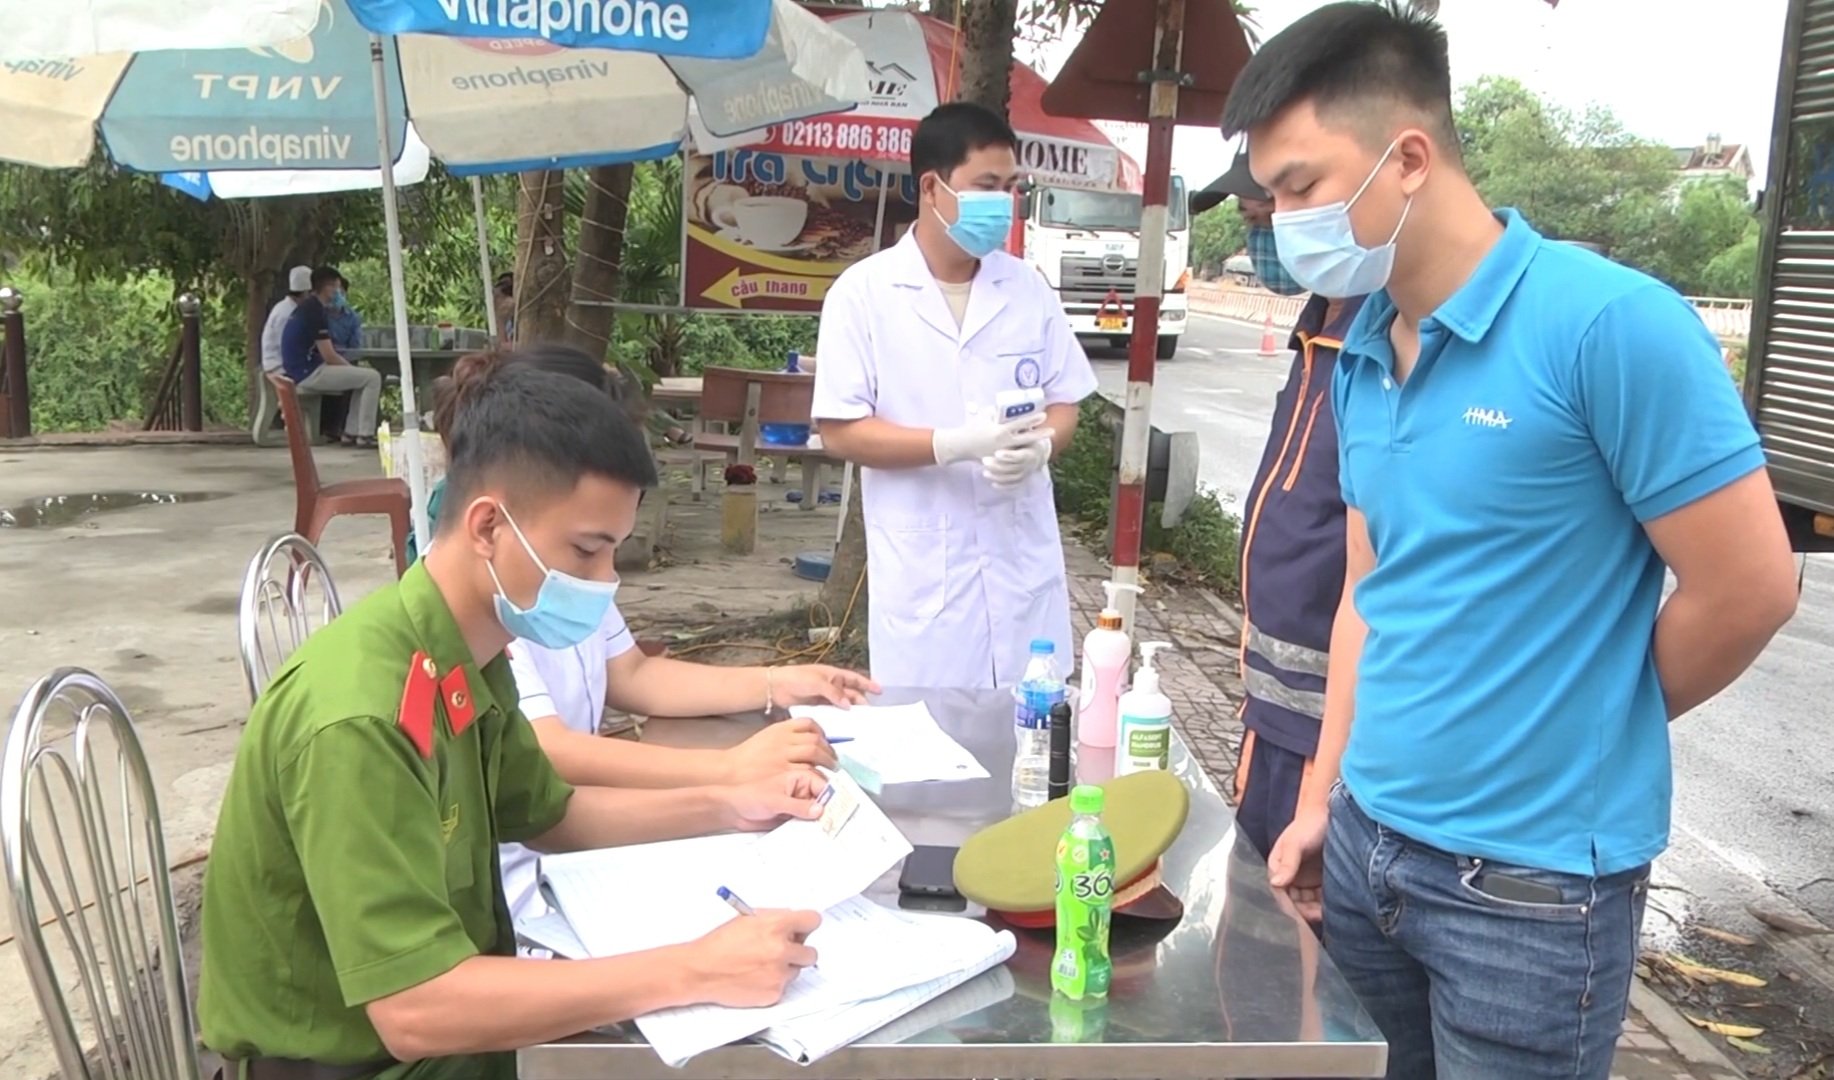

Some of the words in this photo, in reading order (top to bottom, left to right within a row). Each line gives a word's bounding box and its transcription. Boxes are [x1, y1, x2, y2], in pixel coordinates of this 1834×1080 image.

[782, 121, 833, 149] 02113
[836, 123, 873, 151] 886
[876, 126, 912, 155] 386
[765, 280, 807, 295] thang
